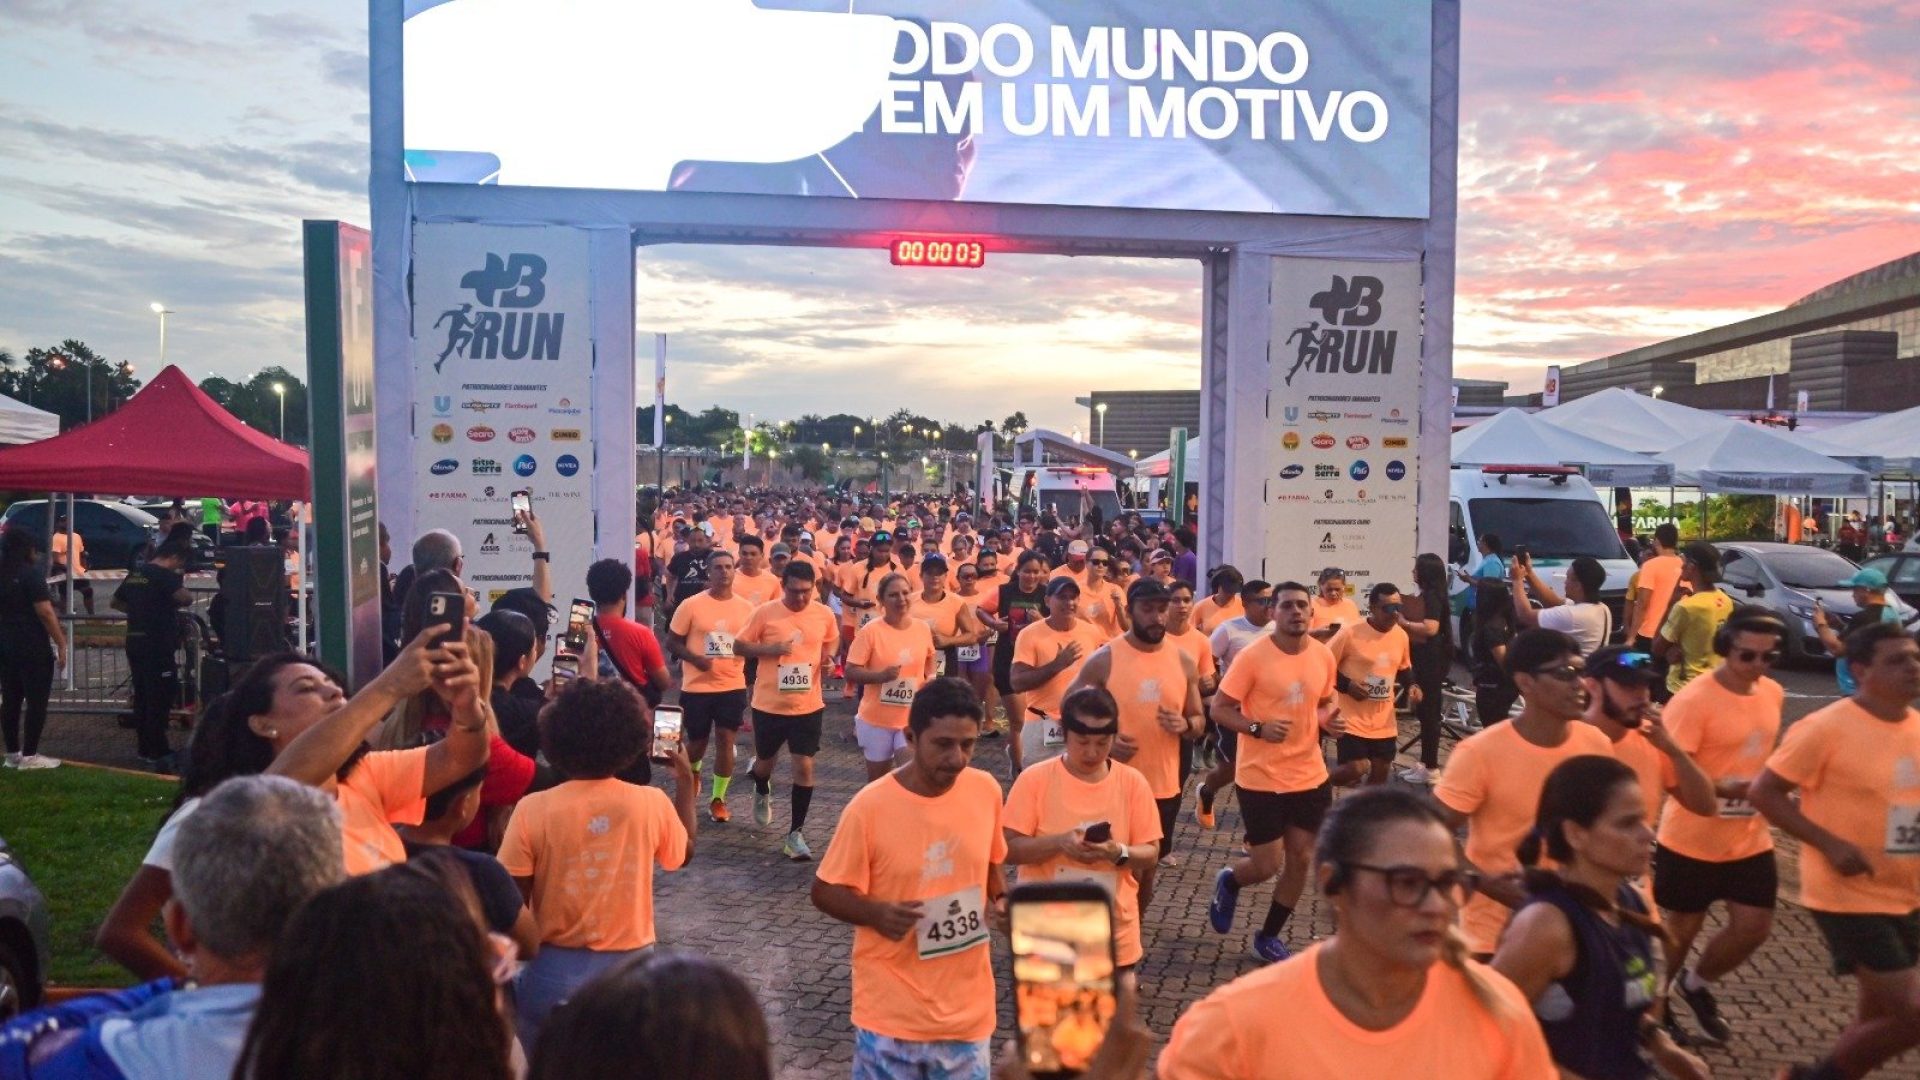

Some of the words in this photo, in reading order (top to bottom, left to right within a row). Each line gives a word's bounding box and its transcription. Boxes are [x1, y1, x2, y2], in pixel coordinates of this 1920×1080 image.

[1051, 25, 1309, 85] MUNDO
[1002, 83, 1109, 137] UM
[1128, 87, 1389, 143] MOTIVO
[469, 311, 565, 360] RUN
[1316, 330, 1397, 374] RUN
[782, 675, 809, 685] 4936
[885, 688, 913, 699] 4403
[926, 911, 980, 943] 4338
